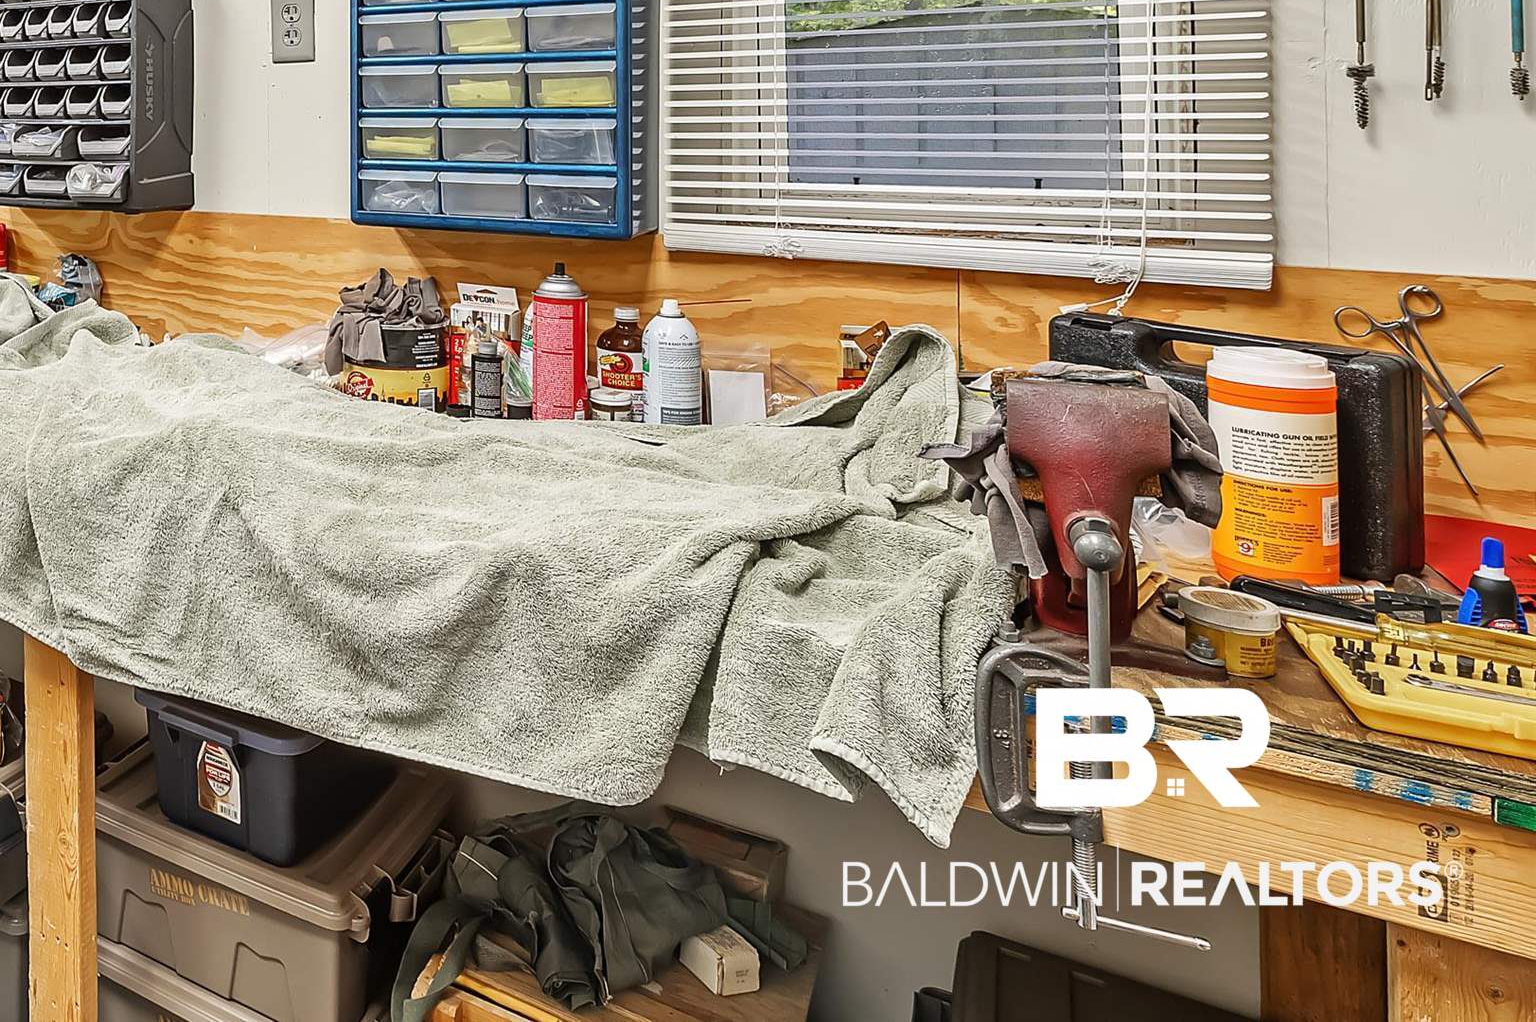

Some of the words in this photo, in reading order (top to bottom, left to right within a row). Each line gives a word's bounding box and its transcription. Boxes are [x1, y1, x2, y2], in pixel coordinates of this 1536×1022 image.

[602, 370, 642, 381] SHOOTER'S
[607, 378, 636, 387] CHOICE
[1232, 426, 1280, 439] LUBRICATING
[1240, 542, 1251, 553] 9
[150, 868, 194, 897] AMMO
[198, 883, 251, 916] CRATE
